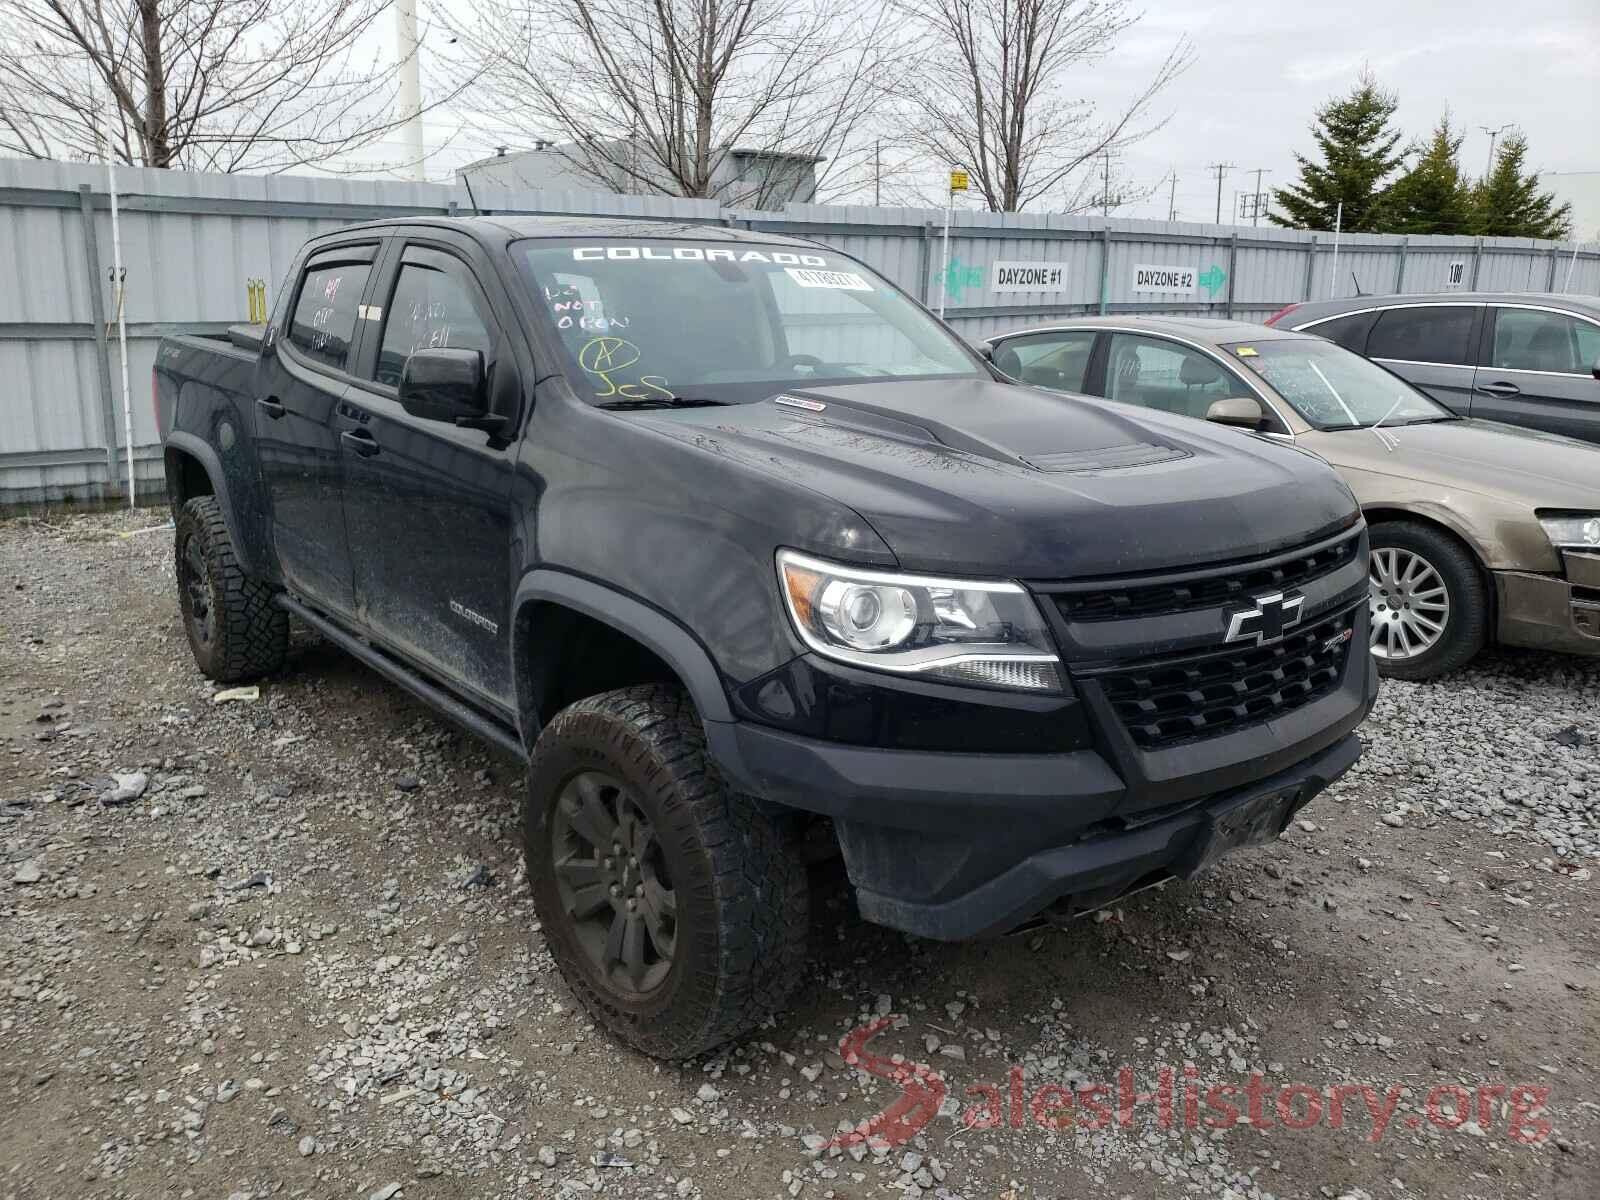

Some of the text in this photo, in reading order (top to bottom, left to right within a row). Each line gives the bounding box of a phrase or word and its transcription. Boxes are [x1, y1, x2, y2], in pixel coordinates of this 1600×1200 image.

[573, 247, 827, 266] COLORADO
[998, 268, 1063, 285] DAYZONE #1
[1137, 270, 1194, 287] DAYZONE #2
[1449, 264, 1463, 283] 100
